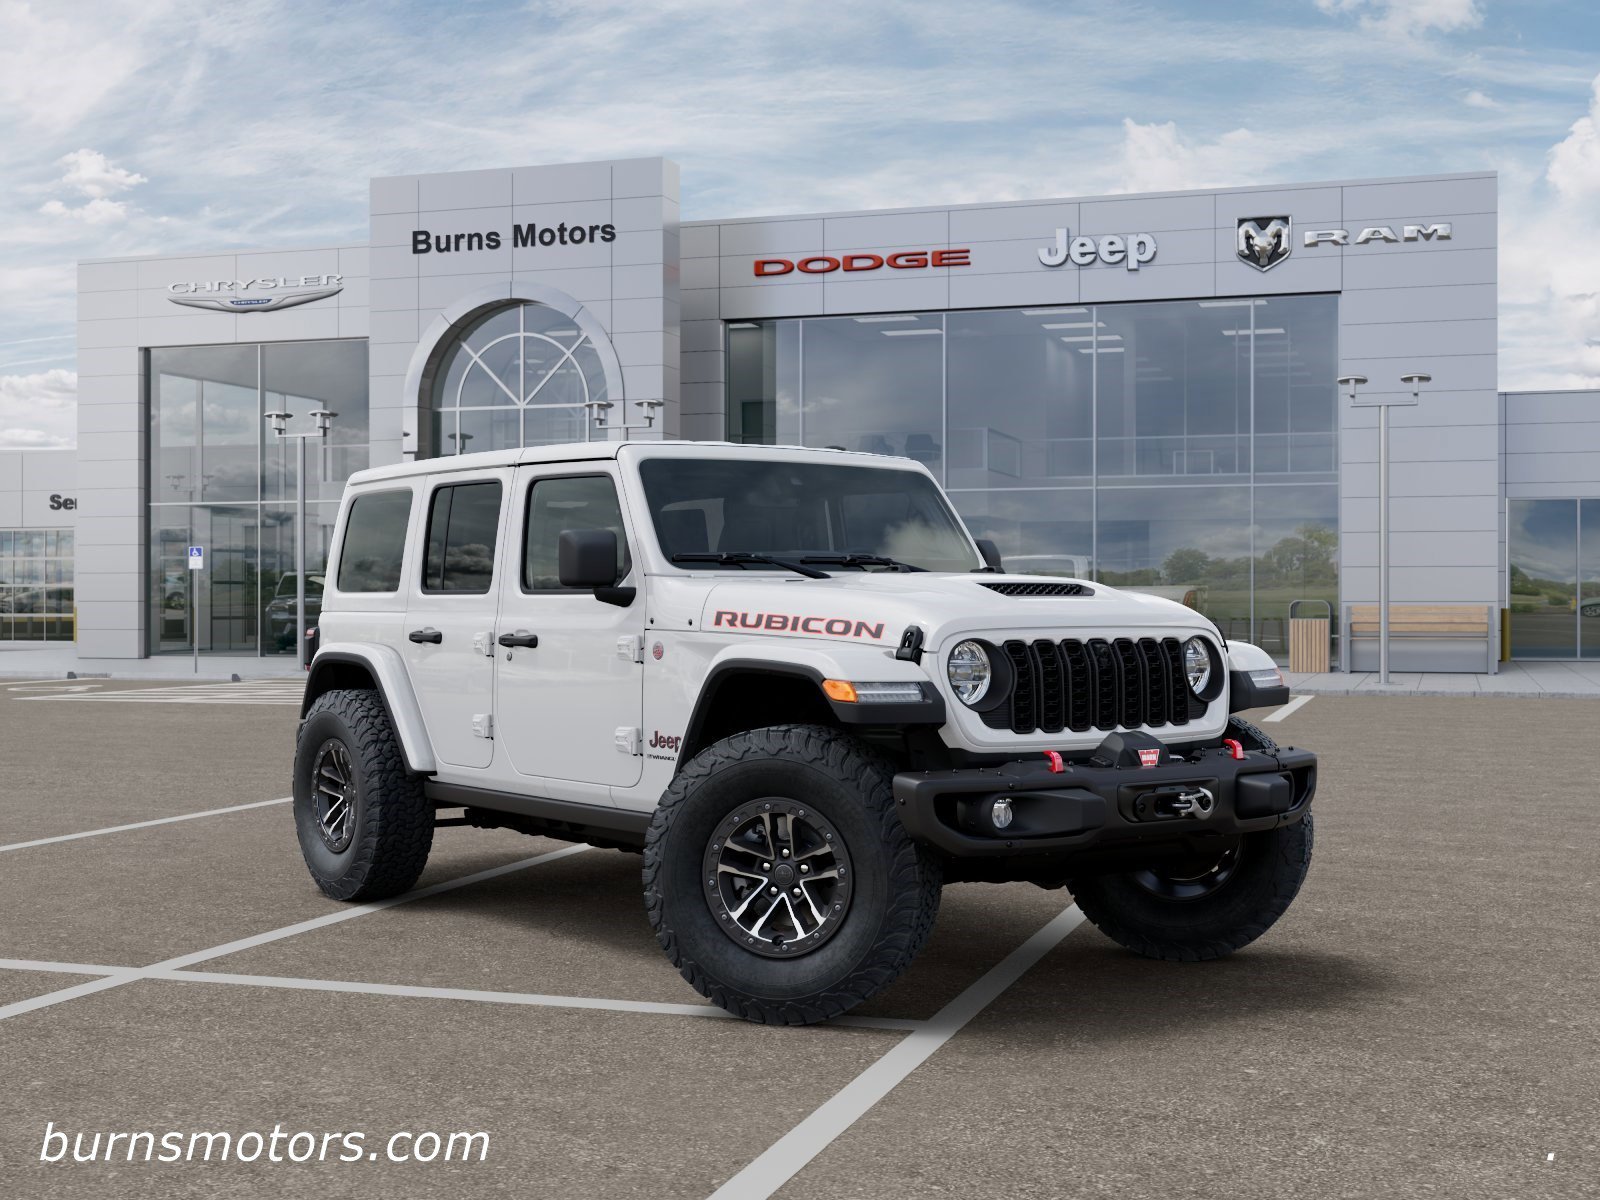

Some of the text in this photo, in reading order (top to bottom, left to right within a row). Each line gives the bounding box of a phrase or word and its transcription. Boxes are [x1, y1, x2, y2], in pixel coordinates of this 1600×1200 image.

[412, 222, 617, 254] Burns Motors
[1304, 222, 1452, 247] RAM
[754, 249, 971, 276] DODGE
[1038, 228, 1157, 271] Jeep
[168, 273, 344, 294] CHRYSLER
[49, 493, 77, 510] Se
[714, 611, 885, 639] RUBICON
